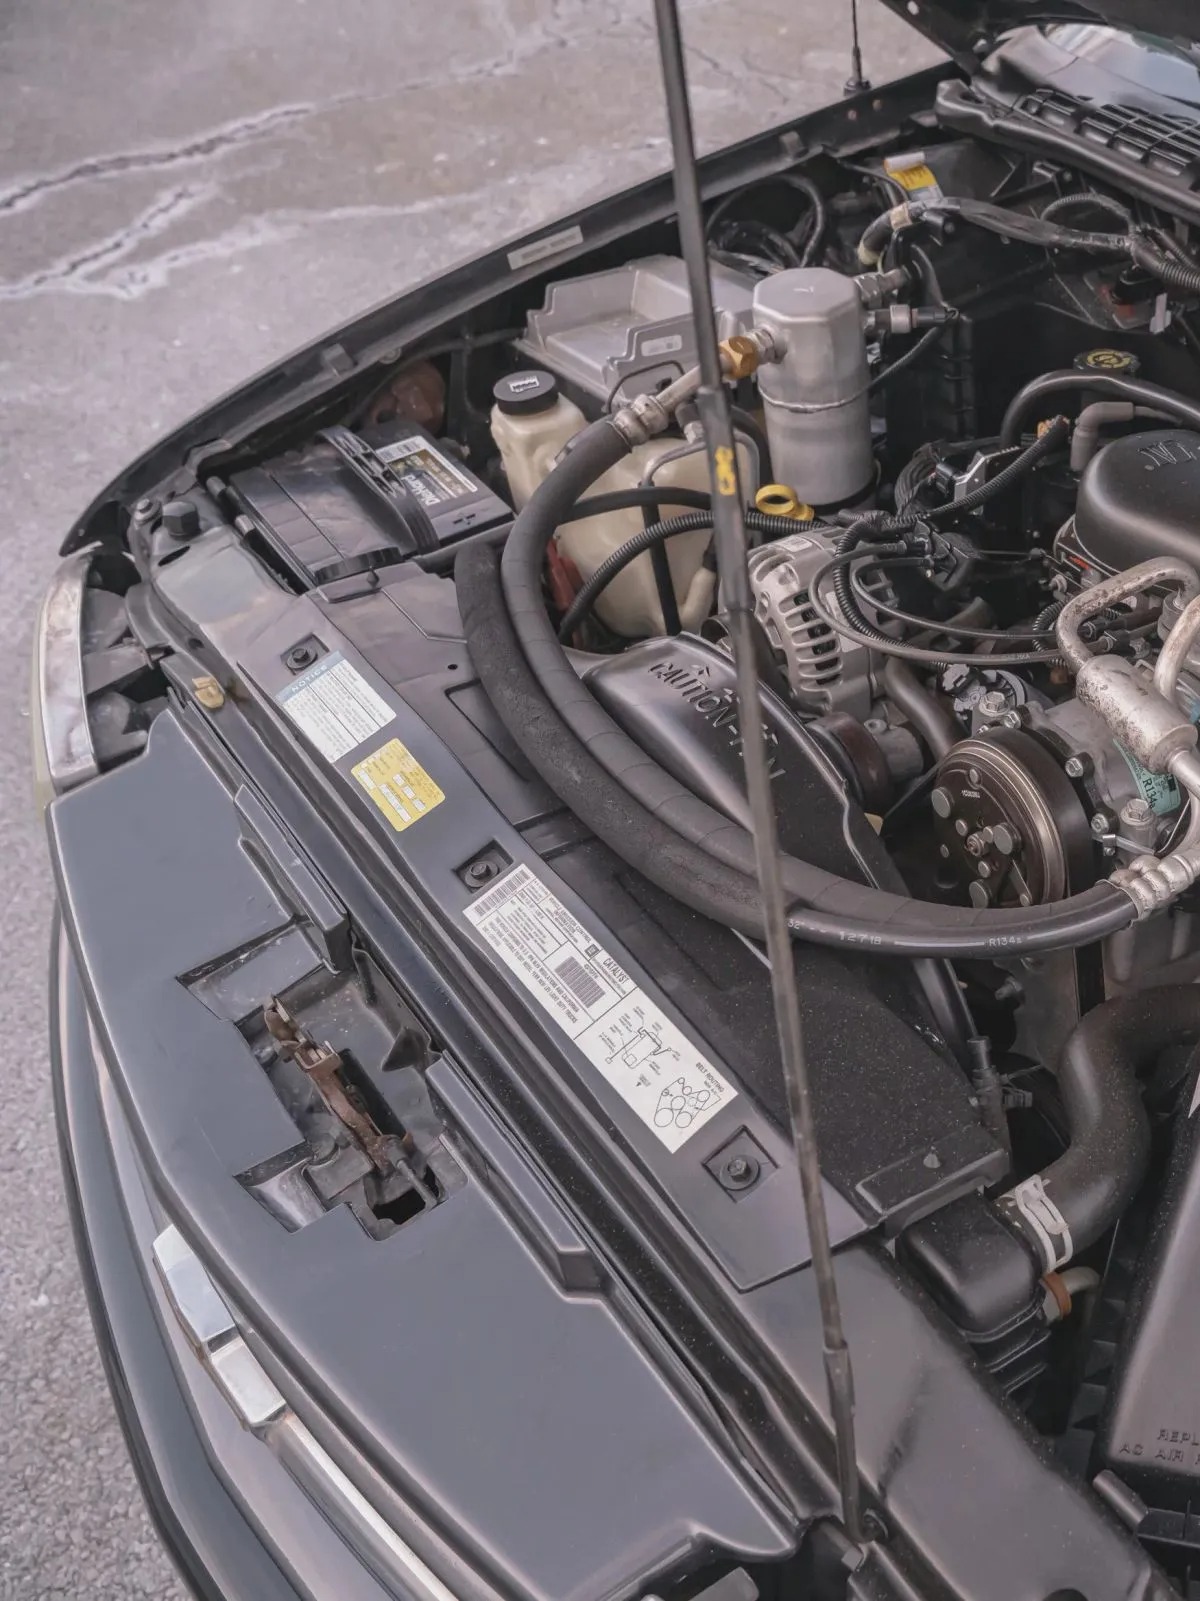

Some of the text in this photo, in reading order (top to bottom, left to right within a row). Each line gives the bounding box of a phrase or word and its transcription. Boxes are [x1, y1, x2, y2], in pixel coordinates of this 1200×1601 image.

[399, 473, 440, 506] DieHard
[290, 663, 328, 692] NOTICE
[1141, 777, 1158, 809] R134a
[601, 956, 629, 985] CATALYST
[1117, 1441, 1146, 1461] AC
[1154, 1445, 1184, 1462] AIR
